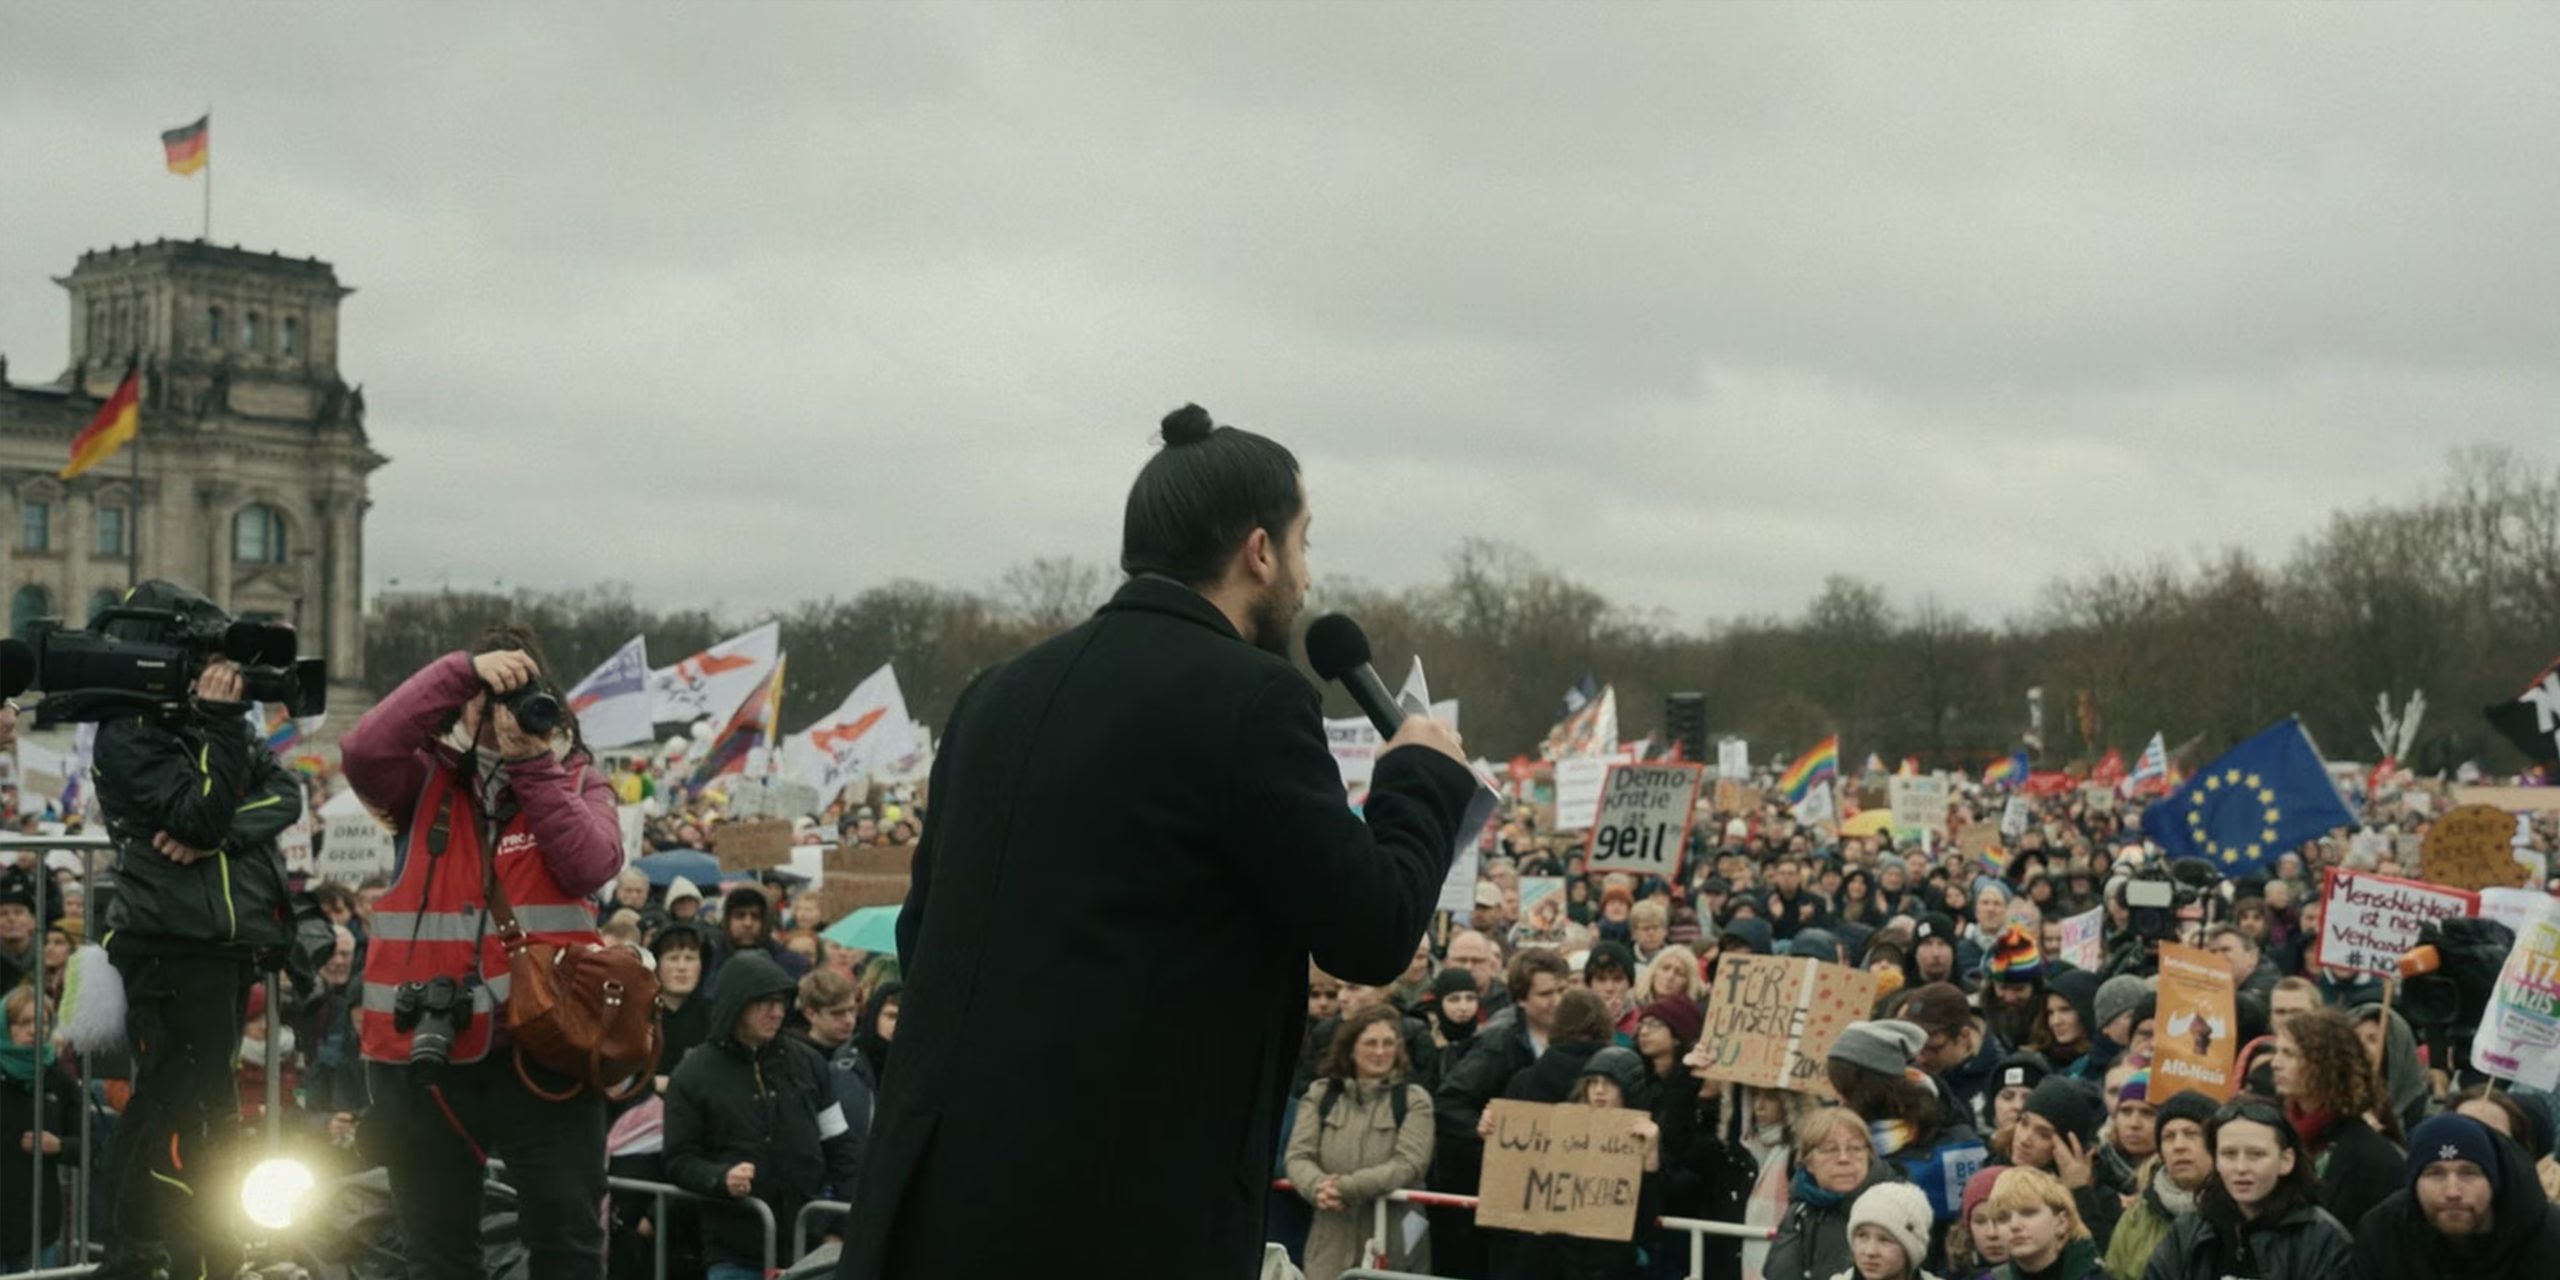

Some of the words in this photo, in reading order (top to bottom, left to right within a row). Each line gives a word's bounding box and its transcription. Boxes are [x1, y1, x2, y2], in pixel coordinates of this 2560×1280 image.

[1594, 822, 1666, 862] geil
[2330, 874, 2462, 921] Menschlichkeit
[2360, 910, 2380, 928] ist
[2389, 913, 2421, 931] nic
[1725, 957, 1786, 1008] FÜR
[2370, 955, 2398, 973] NO
[1712, 1004, 1808, 1039] UNSERE
[1498, 1115, 1552, 1153] Wir
